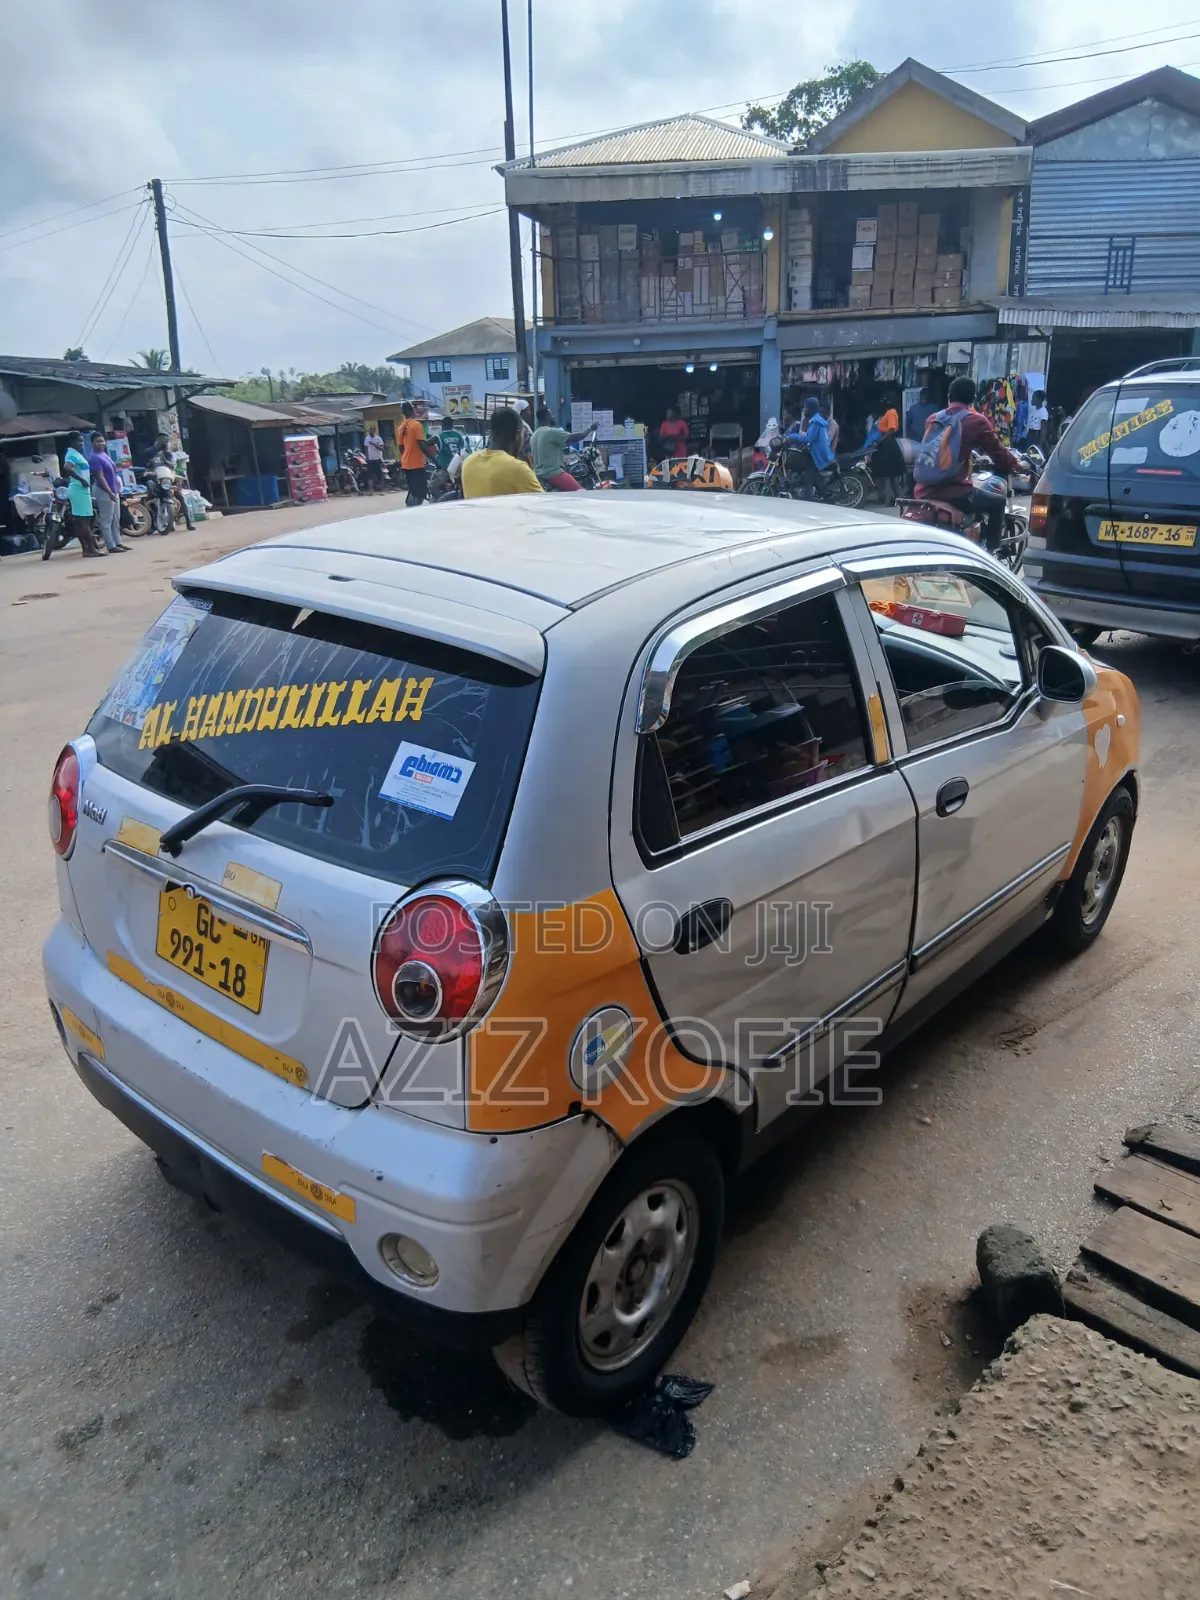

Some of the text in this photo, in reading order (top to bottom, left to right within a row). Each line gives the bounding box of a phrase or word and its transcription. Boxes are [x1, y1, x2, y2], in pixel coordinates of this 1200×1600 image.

[1016, 206, 1024, 237] Infinix
[1014, 246, 1022, 275] Infinix
[138, 677, 435, 750] AL-HAMDULILLAH
[170, 928, 246, 998] 991-18
